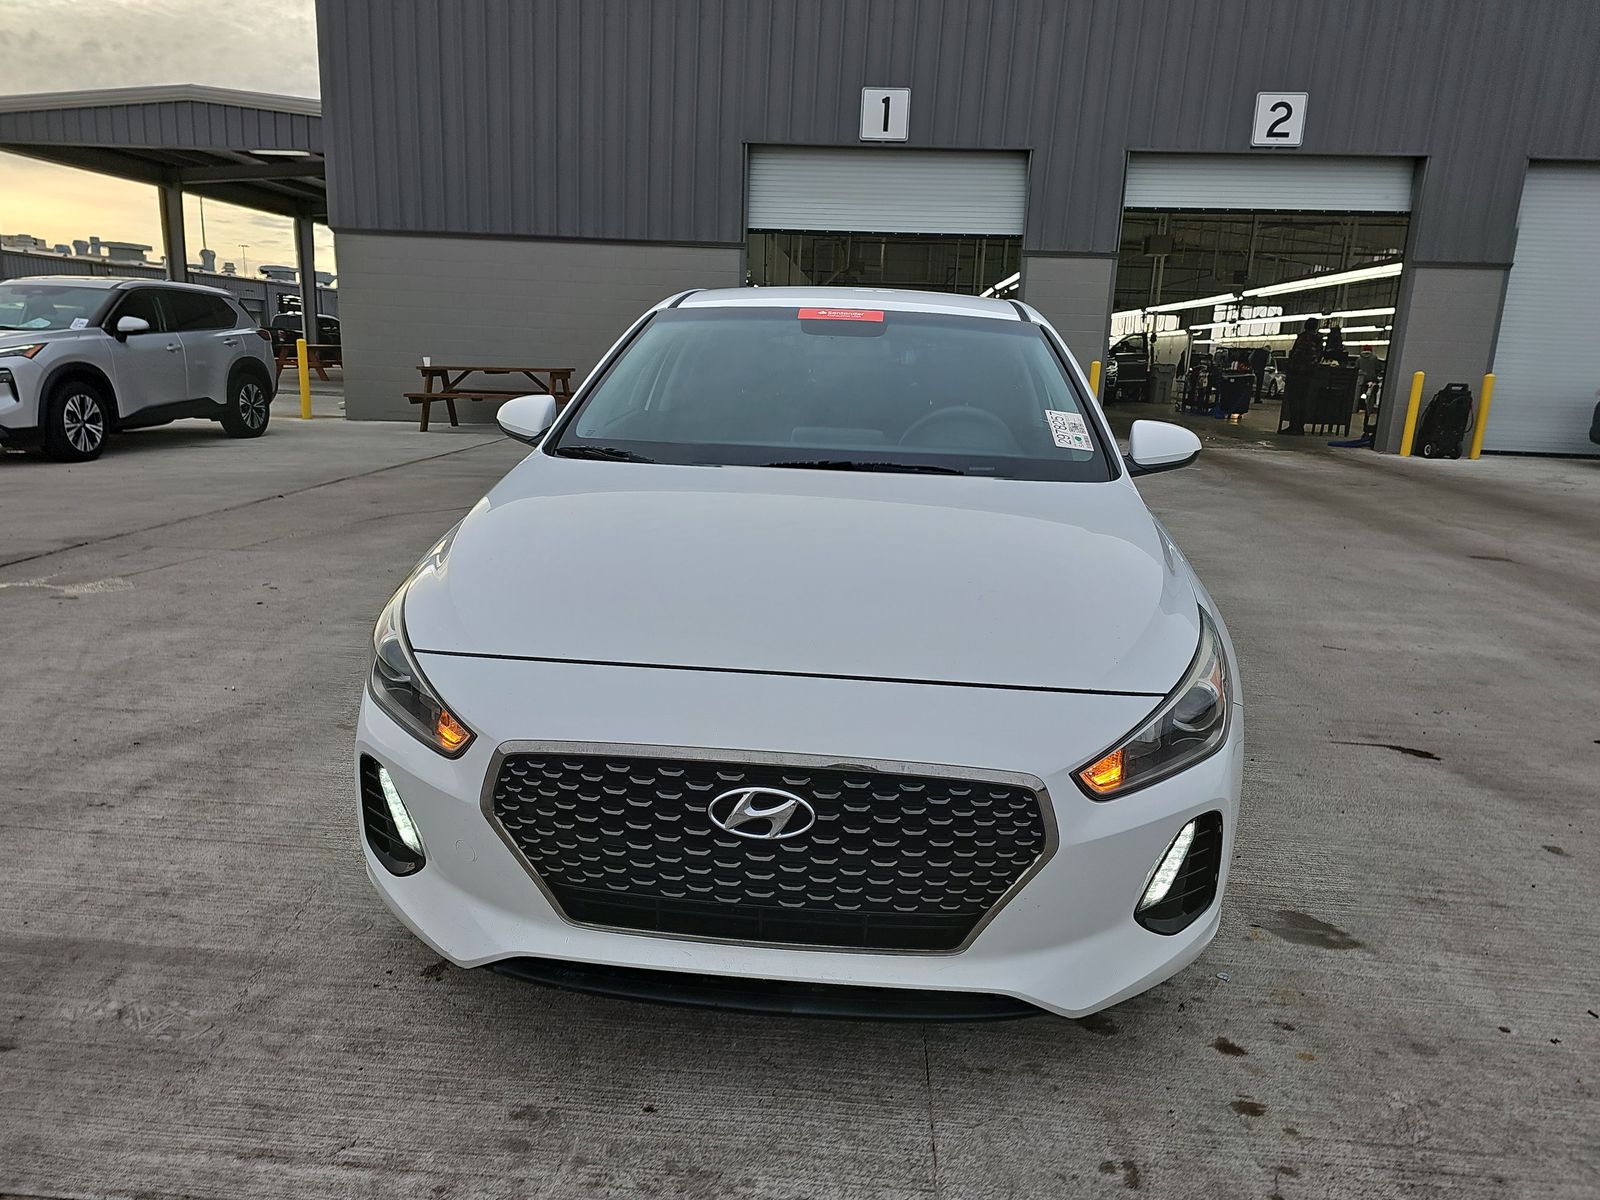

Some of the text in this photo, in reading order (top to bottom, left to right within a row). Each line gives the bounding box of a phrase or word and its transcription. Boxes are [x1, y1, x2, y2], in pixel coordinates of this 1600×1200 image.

[881, 96, 890, 132] 1
[1266, 101, 1293, 138] 2
[1049, 411, 1072, 445] 2978257
